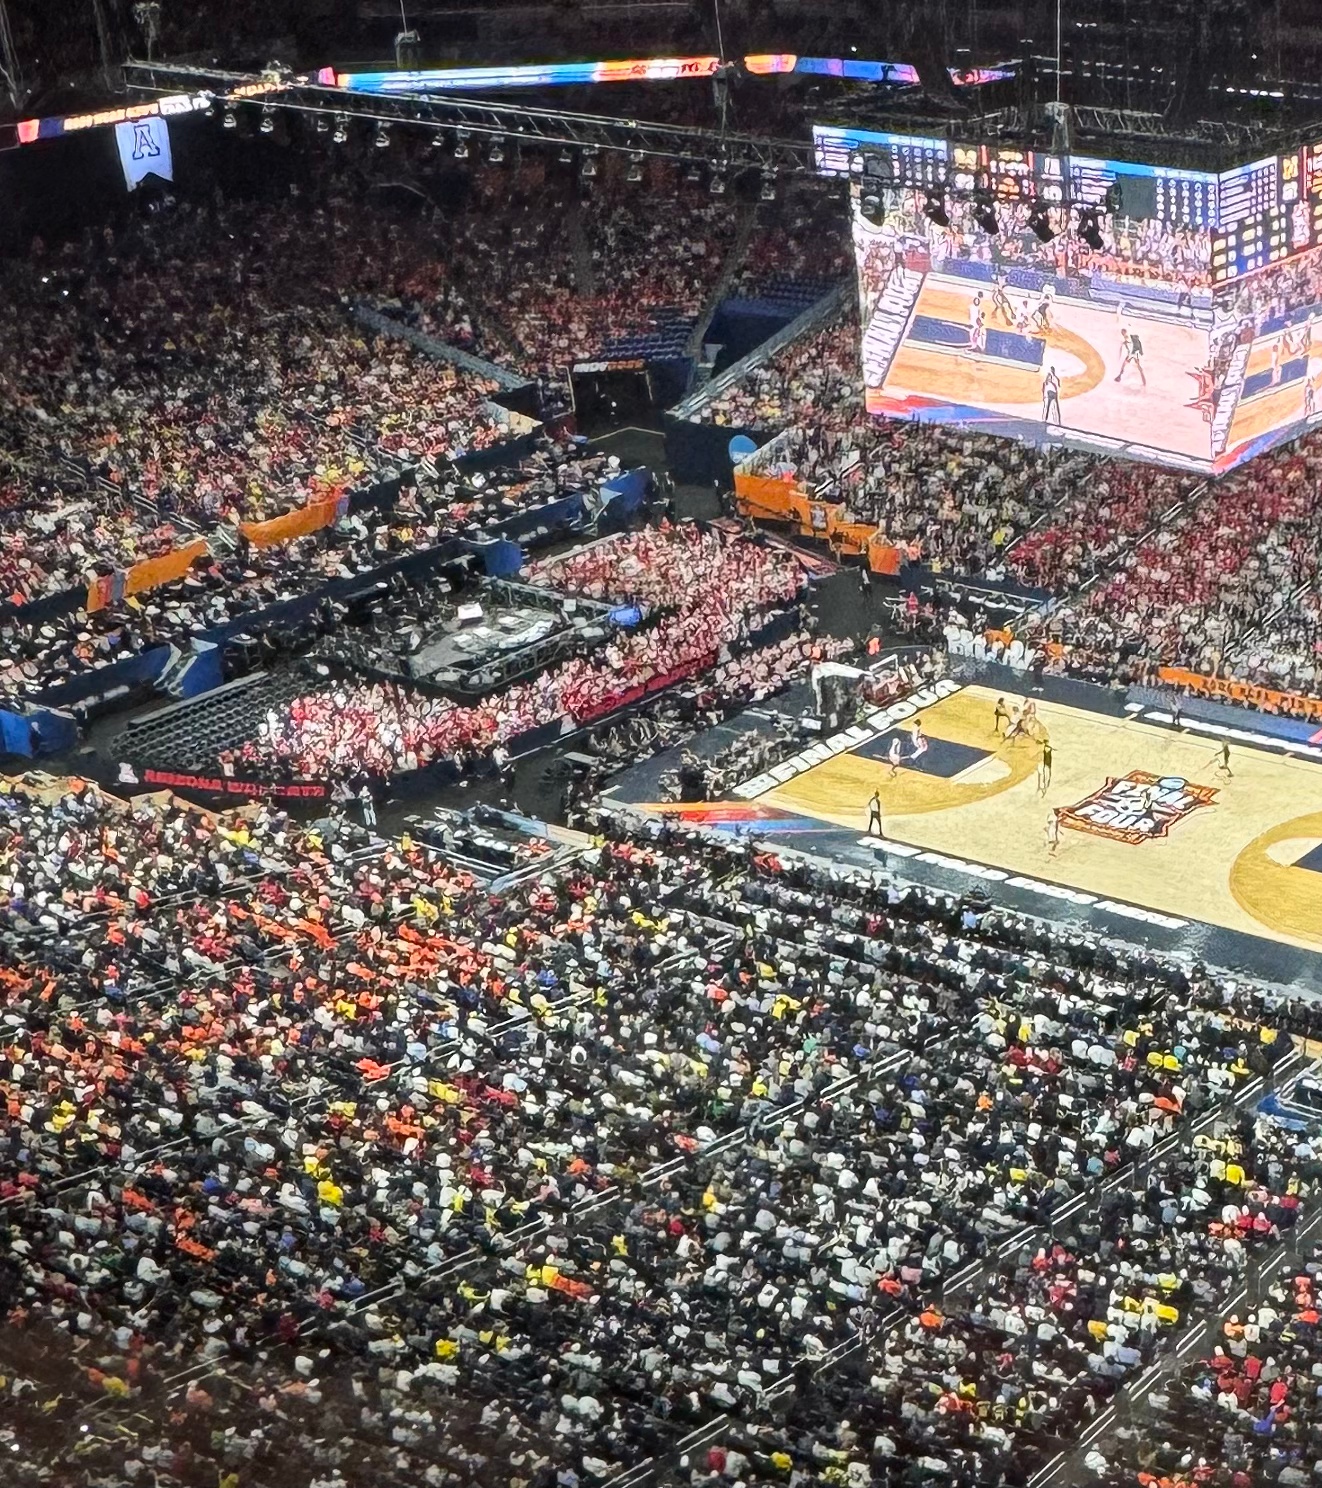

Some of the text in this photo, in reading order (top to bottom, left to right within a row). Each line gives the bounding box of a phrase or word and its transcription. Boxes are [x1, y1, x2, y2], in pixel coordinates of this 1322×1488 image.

[132, 124, 161, 160] A
[768, 679, 962, 784] FINAL FOUR
[1074, 803, 1155, 833] FOUR
